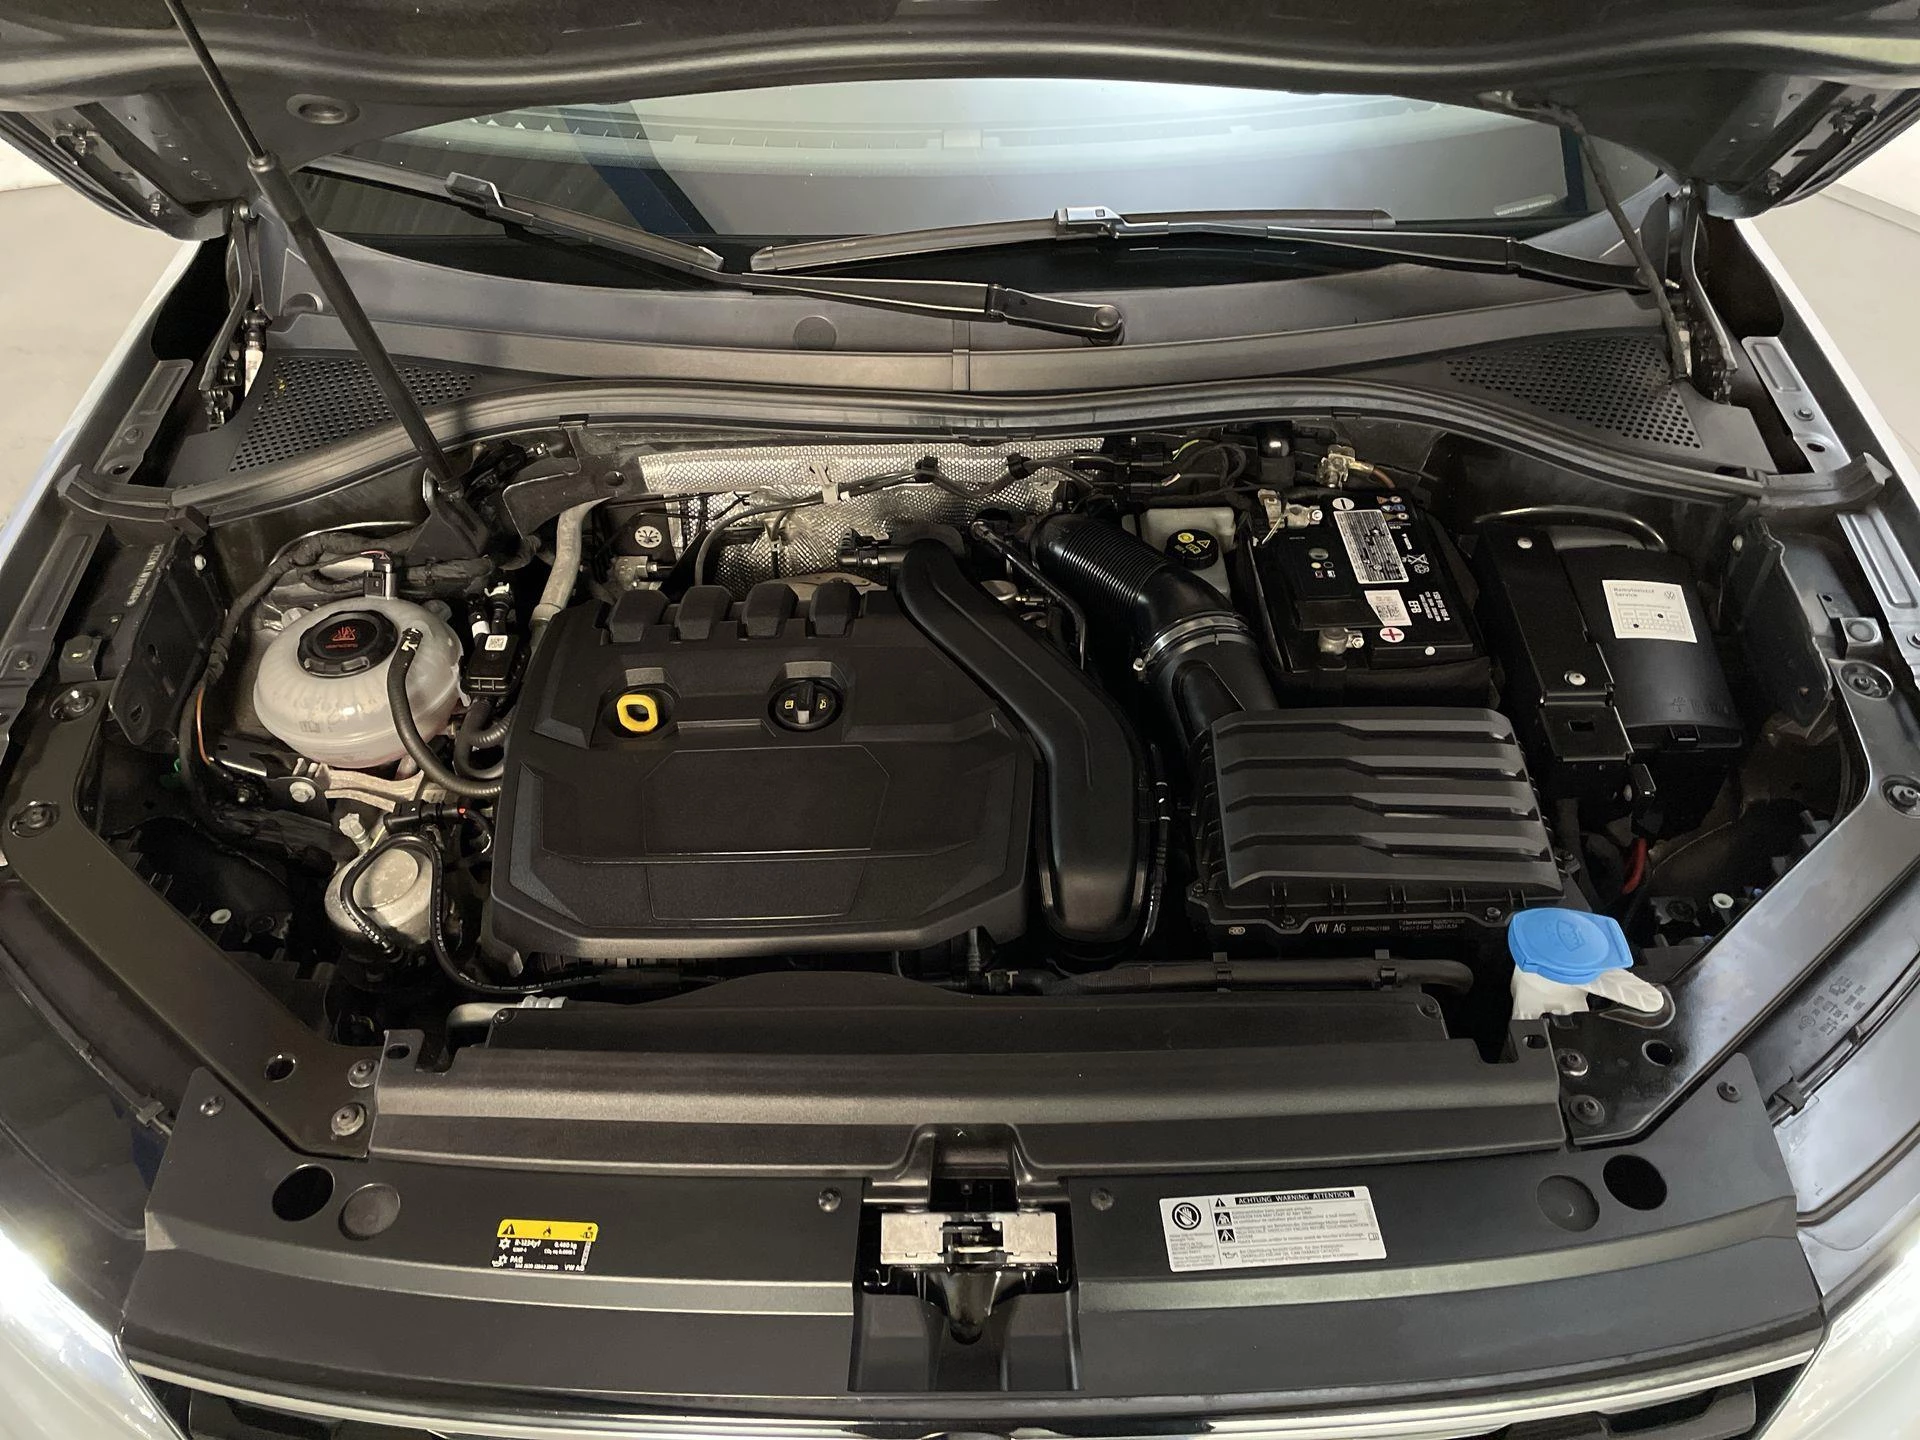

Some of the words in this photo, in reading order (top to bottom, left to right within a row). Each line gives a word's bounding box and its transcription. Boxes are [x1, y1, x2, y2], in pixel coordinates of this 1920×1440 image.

[1408, 600, 1422, 613] EFB
[1314, 923, 1328, 934] VW
[1332, 923, 1346, 934] AG
[1239, 1195, 1273, 1204] ACHTUNG
[1275, 1193, 1310, 1202] WARNING
[1312, 1190, 1351, 1200] ATTENTION
